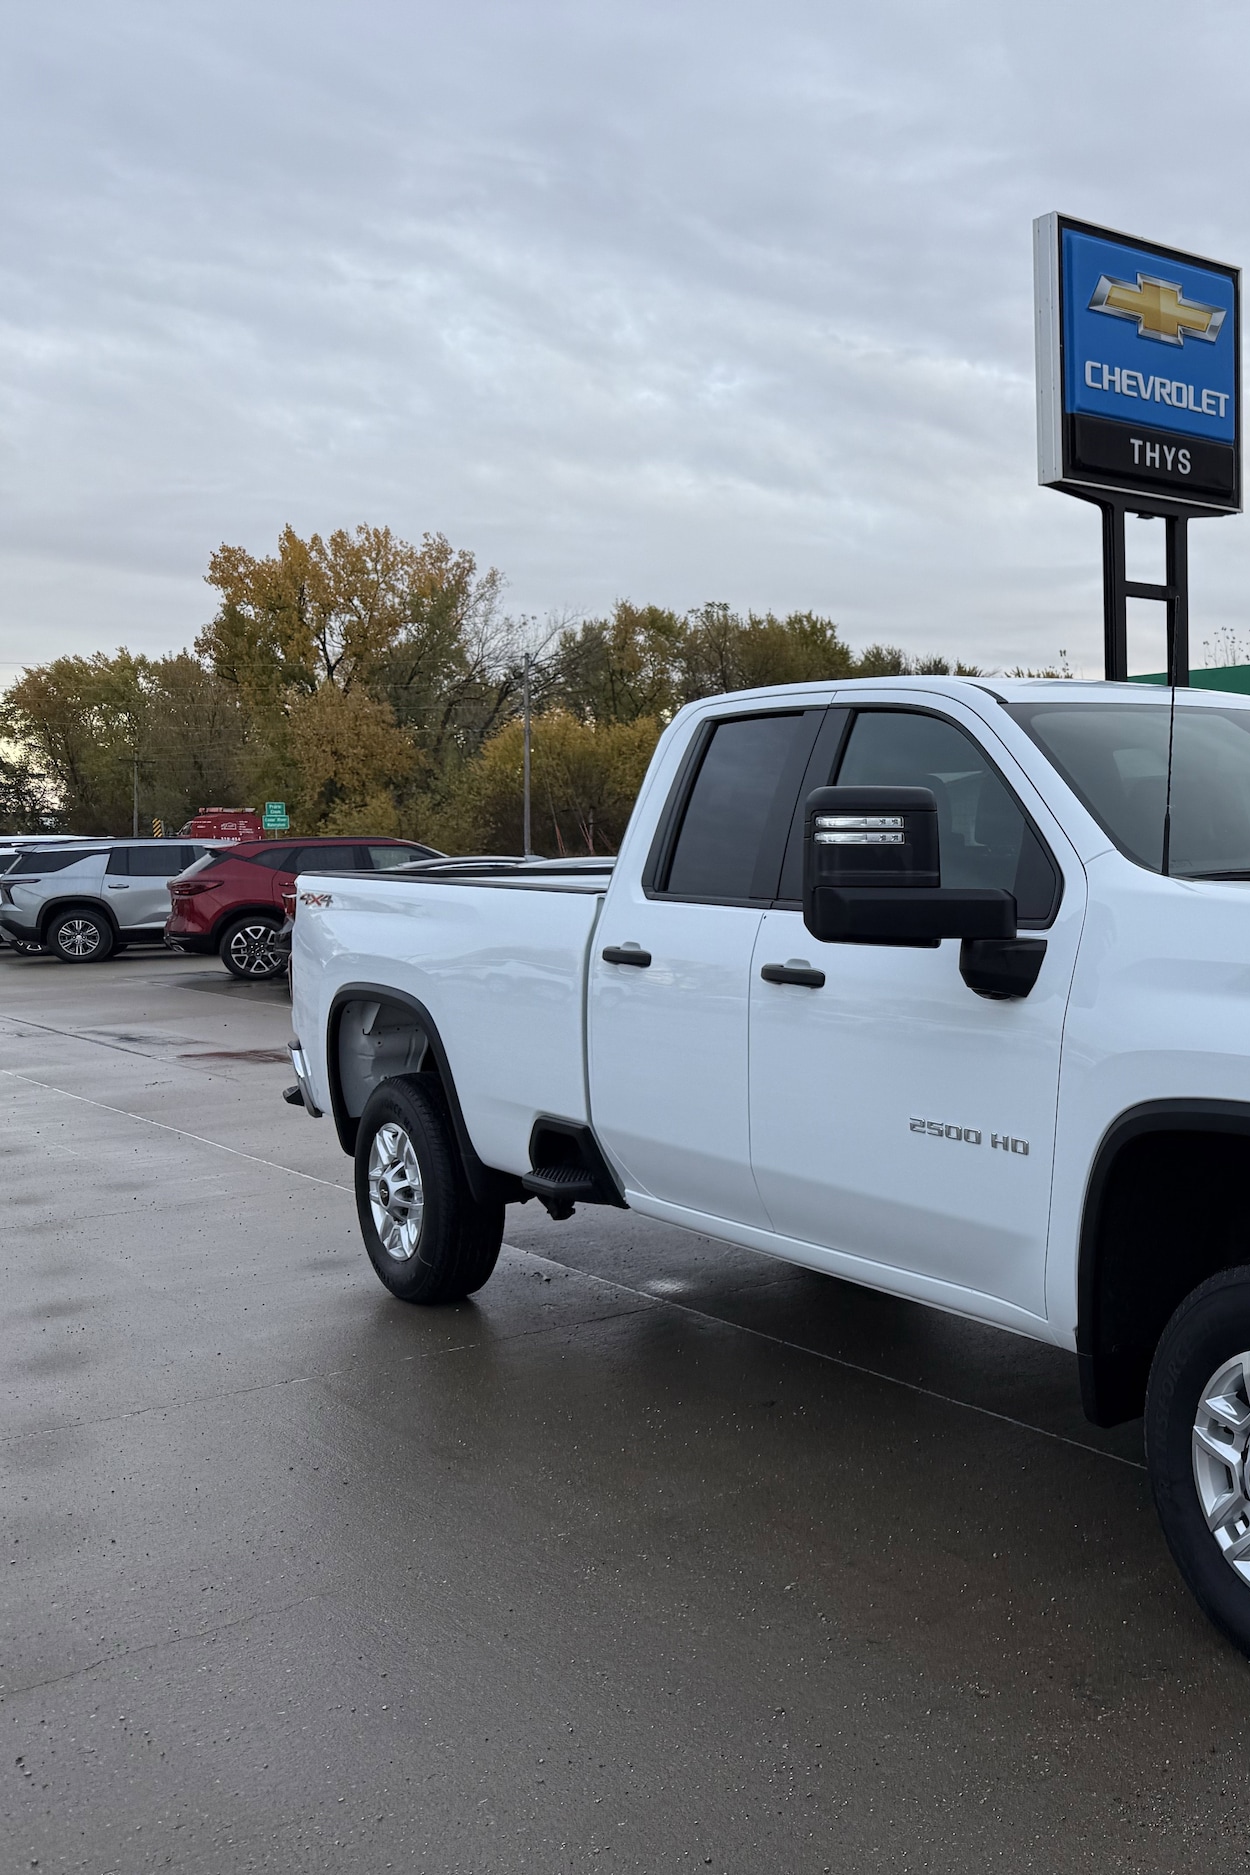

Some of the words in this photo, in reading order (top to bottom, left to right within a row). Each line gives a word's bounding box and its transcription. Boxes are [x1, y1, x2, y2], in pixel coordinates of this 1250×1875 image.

[1084, 360, 1229, 417] CHEVROLET
[1130, 438, 1192, 475] THYS
[909, 1116, 982, 1145] 2500
[990, 1131, 1030, 1155] HD
